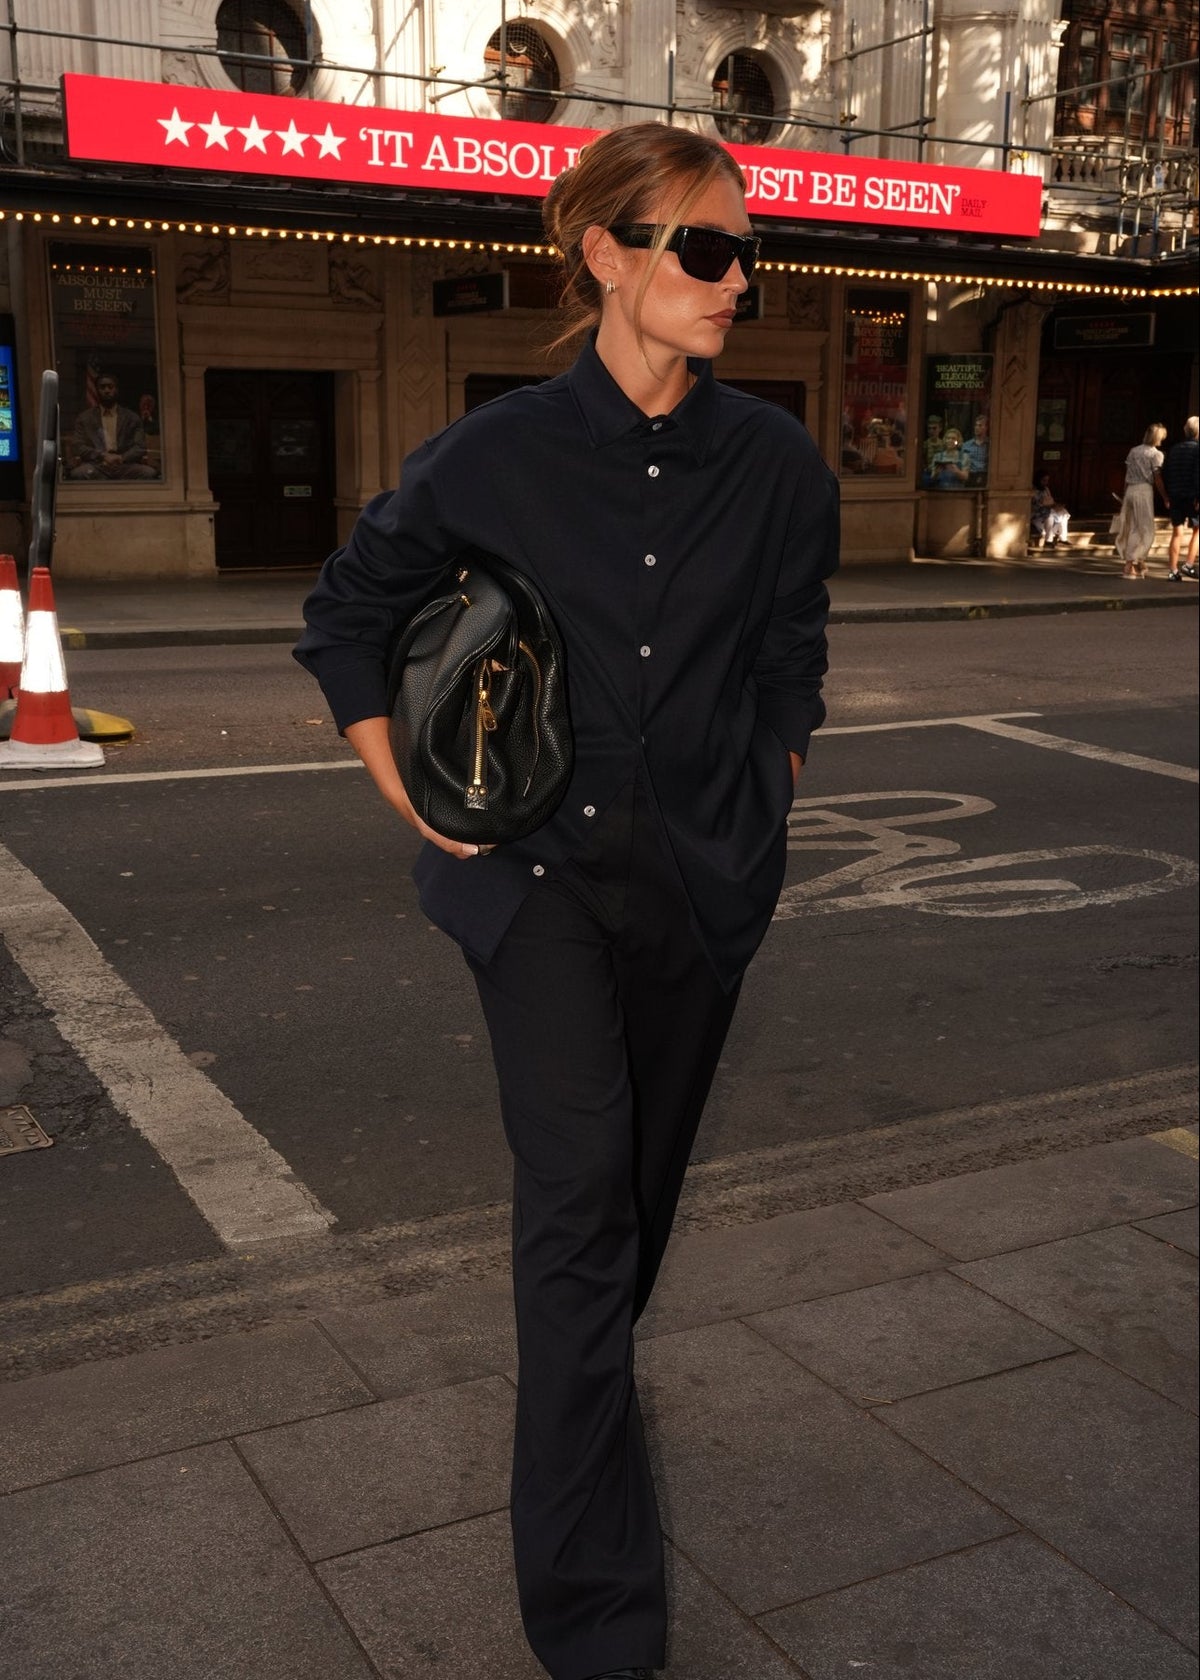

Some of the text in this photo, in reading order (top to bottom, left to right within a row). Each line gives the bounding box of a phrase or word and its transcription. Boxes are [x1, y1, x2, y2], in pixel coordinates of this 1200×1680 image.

[359, 127, 413, 168] ‘IT
[738, 164, 804, 202] UST
[809, 172, 857, 207] BE
[863, 176, 961, 215] SEEN’
[84, 287, 122, 299] MUST
[74, 300, 93, 311] BE
